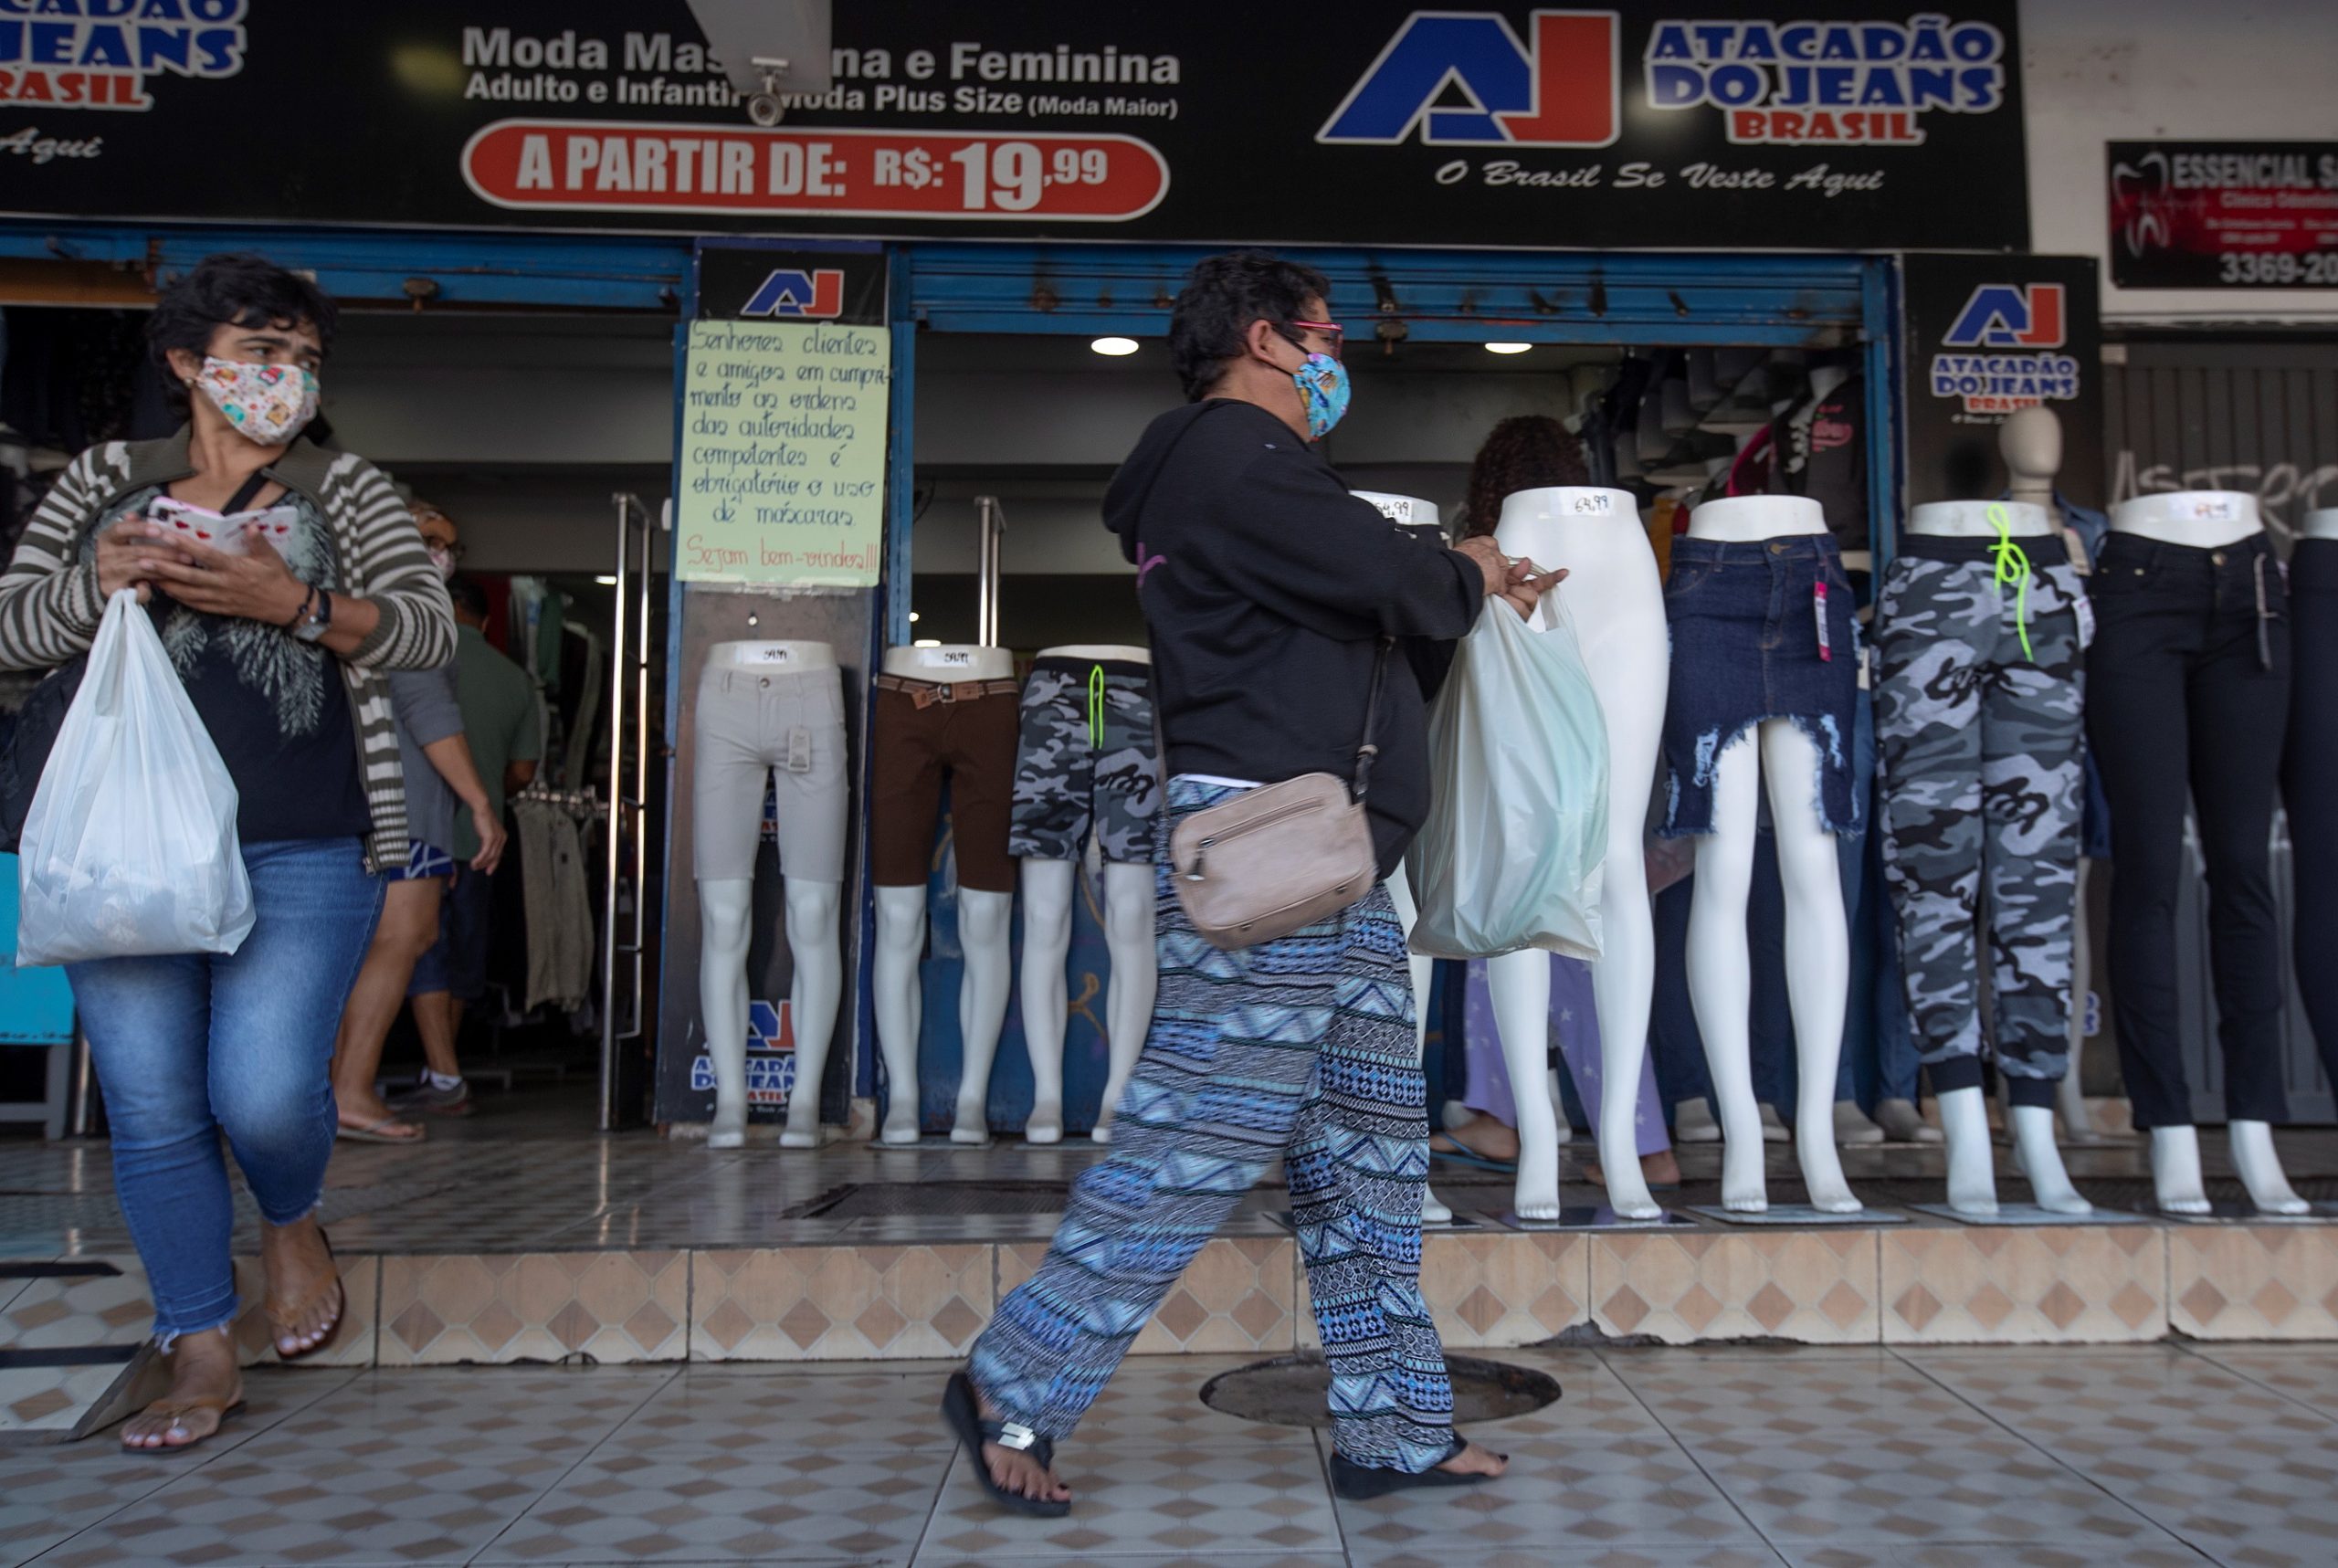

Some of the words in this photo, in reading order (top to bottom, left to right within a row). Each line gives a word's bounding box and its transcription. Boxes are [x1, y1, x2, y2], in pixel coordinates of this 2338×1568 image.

[462, 26, 608, 69] Moda
[624, 32, 891, 79] Masna
[905, 51, 936, 80] e
[950, 42, 1181, 84] Feminina
[1648, 16, 2000, 63] ATACADÃO
[1315, 10, 1619, 146] AJ
[1649, 63, 1763, 108] DO
[1775, 65, 1997, 109] JEANS
[465, 72, 579, 104] Adulto
[586, 81, 608, 103] e
[875, 85, 946, 113] Plus
[953, 87, 1023, 115] Size
[1028, 95, 1100, 118] (Moda
[1104, 97, 1179, 121] Maior)
[1732, 110, 1921, 142] BRASIL
[516, 134, 553, 189] A
[566, 135, 755, 195] PARTIR
[768, 142, 847, 197] DE:
[873, 147, 943, 189] R$:
[951, 142, 1109, 211] 19,99
[1435, 160, 1469, 184] O
[1482, 160, 1602, 187] Brasil
[1613, 162, 1666, 188] Se
[1680, 162, 1775, 190] Veste
[1784, 164, 1885, 197] Aqui
[2172, 153, 2314, 190] ESSENCIAL
[690, 320, 784, 353] Senhores
[803, 328, 877, 356] clientes
[696, 361, 708, 378] e
[717, 361, 785, 389] amigos
[796, 364, 825, 382] em
[1933, 354, 2077, 375] ATACADÃO
[690, 383, 742, 407] mento
[790, 385, 857, 411] ordens
[1934, 374, 1979, 395] DO
[1987, 376, 2077, 396] JEANS
[692, 411, 728, 436] das
[739, 411, 855, 439] autoridades
[693, 442, 806, 473] competentes
[830, 444, 848, 468] é
[692, 468, 800, 502] obrigatório
[807, 480, 823, 497] o
[834, 481, 875, 498] uso
[1575, 495, 1608, 512] 64,99
